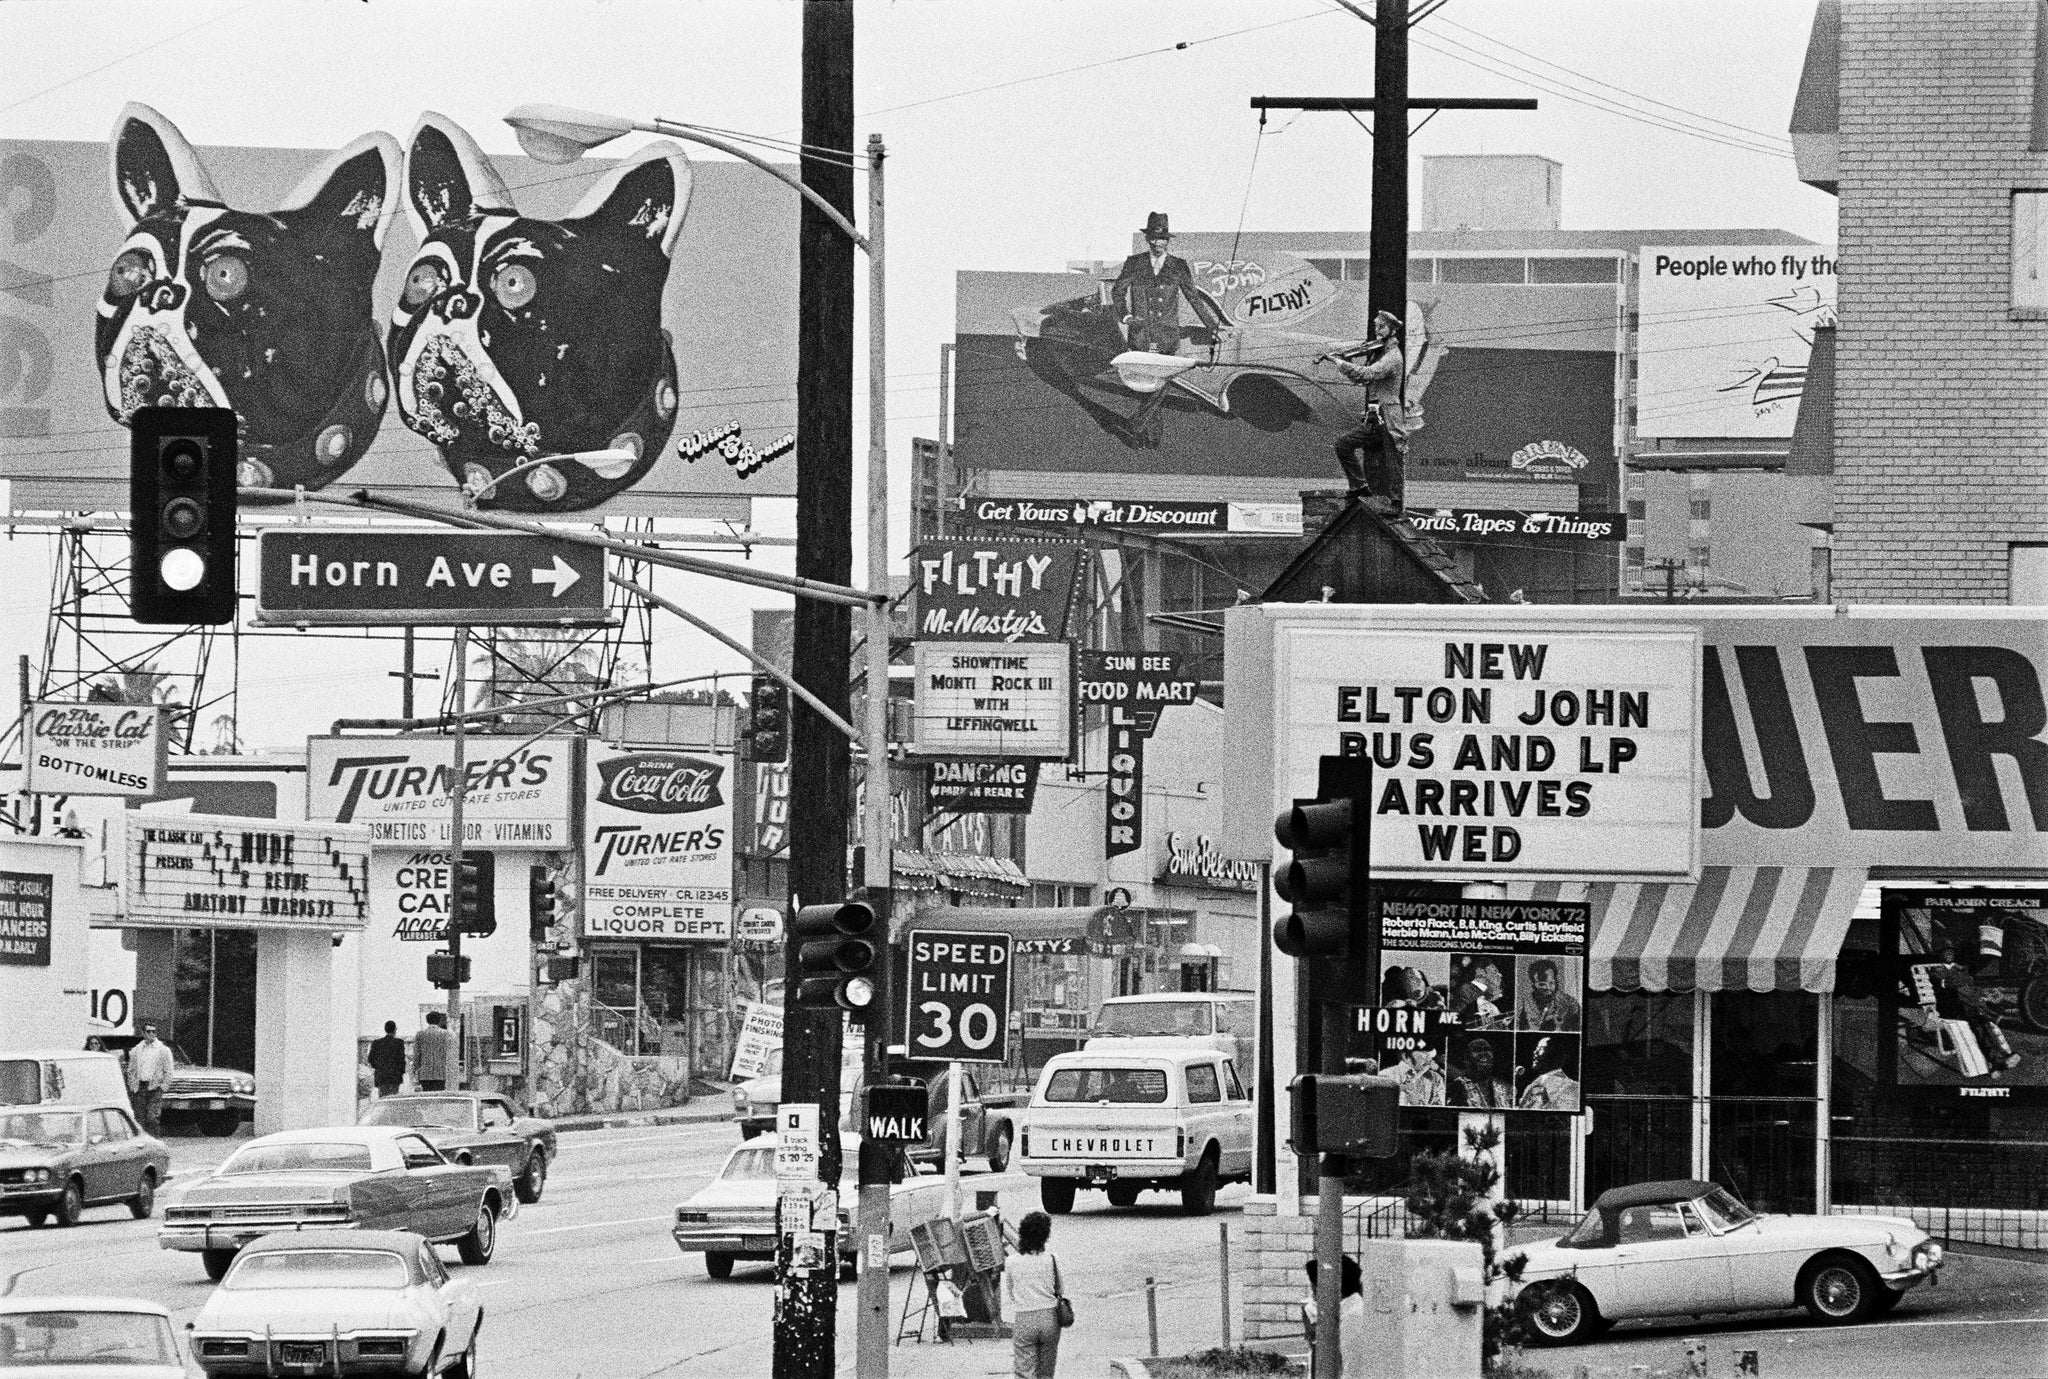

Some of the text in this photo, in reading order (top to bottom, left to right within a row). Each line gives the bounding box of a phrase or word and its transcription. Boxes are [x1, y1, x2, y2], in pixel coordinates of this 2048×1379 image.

[1656, 255, 1728, 280] People
[1733, 256, 1776, 275] who
[1781, 256, 1807, 280] fly
[978, 502, 1218, 525] Get Yours at Discount
[1463, 513, 1516, 535] Tapes
[1522, 517, 1541, 533] &
[1546, 514, 1612, 539] Things
[291, 554, 512, 587] Horn Ave
[921, 551, 1052, 598] FILTHY
[924, 607, 1049, 643] McNasty's
[952, 656, 1028, 670] SHOWTIME
[1104, 656, 1171, 671] SUN BEE
[1444, 643, 1548, 680] NEW
[931, 675, 1052, 691] MONTI ROCK III
[1079, 681, 1196, 700] FOOD MART
[974, 697, 1009, 711] WITH
[1337, 686, 1649, 729] ELTON JOHN
[35, 709, 154, 739] Classic Cat
[67, 708, 101, 724] The
[947, 717, 1038, 732] LEFFINGWELL
[75, 738, 96, 749] THE
[1700, 645, 2048, 832] WER
[1453, 735, 1556, 771] AND
[1579, 736, 1638, 773] LP
[39, 754, 148, 790] BOTTOMLESS
[638, 761, 676, 770] DRINK
[934, 762, 1027, 784] DANCING
[1111, 706, 1136, 844] LIQUOR
[328, 750, 553, 824] TURNER'S
[610, 766, 715, 803] Coca-Cola
[984, 787, 1013, 798] REAR
[383, 800, 427, 812] UNITED
[496, 790, 542, 802] STORES
[1377, 779, 1593, 818] ARRIVES
[361, 822, 553, 841] OSMETICS LIUOR VITAMINS
[240, 831, 294, 866] NUDE
[594, 824, 725, 877] TURNER'S
[1418, 824, 1522, 862] WED
[407, 853, 452, 866] MOS
[589, 887, 615, 898] FREE
[618, 888, 668, 899] DELIVERY
[695, 890, 729, 901] 12345
[1955, 898, 1987, 908] JOHN
[1989, 898, 2040, 909] CREACH
[613, 905, 705, 919] COMPLETE
[1382, 902, 1586, 921] NEWPORT IN NEW YORK '72
[592, 918, 725, 935] LIQUOR DEPT.
[1382, 916, 1426, 929] Roberta
[1427, 918, 1458, 930] Flack,
[1505, 921, 1537, 932] Curtis
[1538, 921, 1585, 934] Mayfield
[1382, 927, 1418, 938] Herbie
[1419, 928, 1452, 940] Mann,
[1452, 929, 1470, 940] Les
[1519, 932, 1540, 943] Billy
[1541, 932, 1585, 943] Eckstine
[916, 942, 1006, 965] SPEED
[1382, 939, 1397, 948] THE
[1398, 939, 1420, 949] SOUL
[922, 972, 995, 994] LIMIT
[750, 1016, 783, 1030] PHOTO
[916, 1001, 998, 1050] 30
[1358, 1008, 1462, 1034] HORN AVE.
[1386, 1037, 1416, 1050] 1100
[1960, 1087, 2011, 1098] FILTHY!
[870, 1116, 923, 1140] WALK
[1051, 1138, 1154, 1152] CHEVROLET
